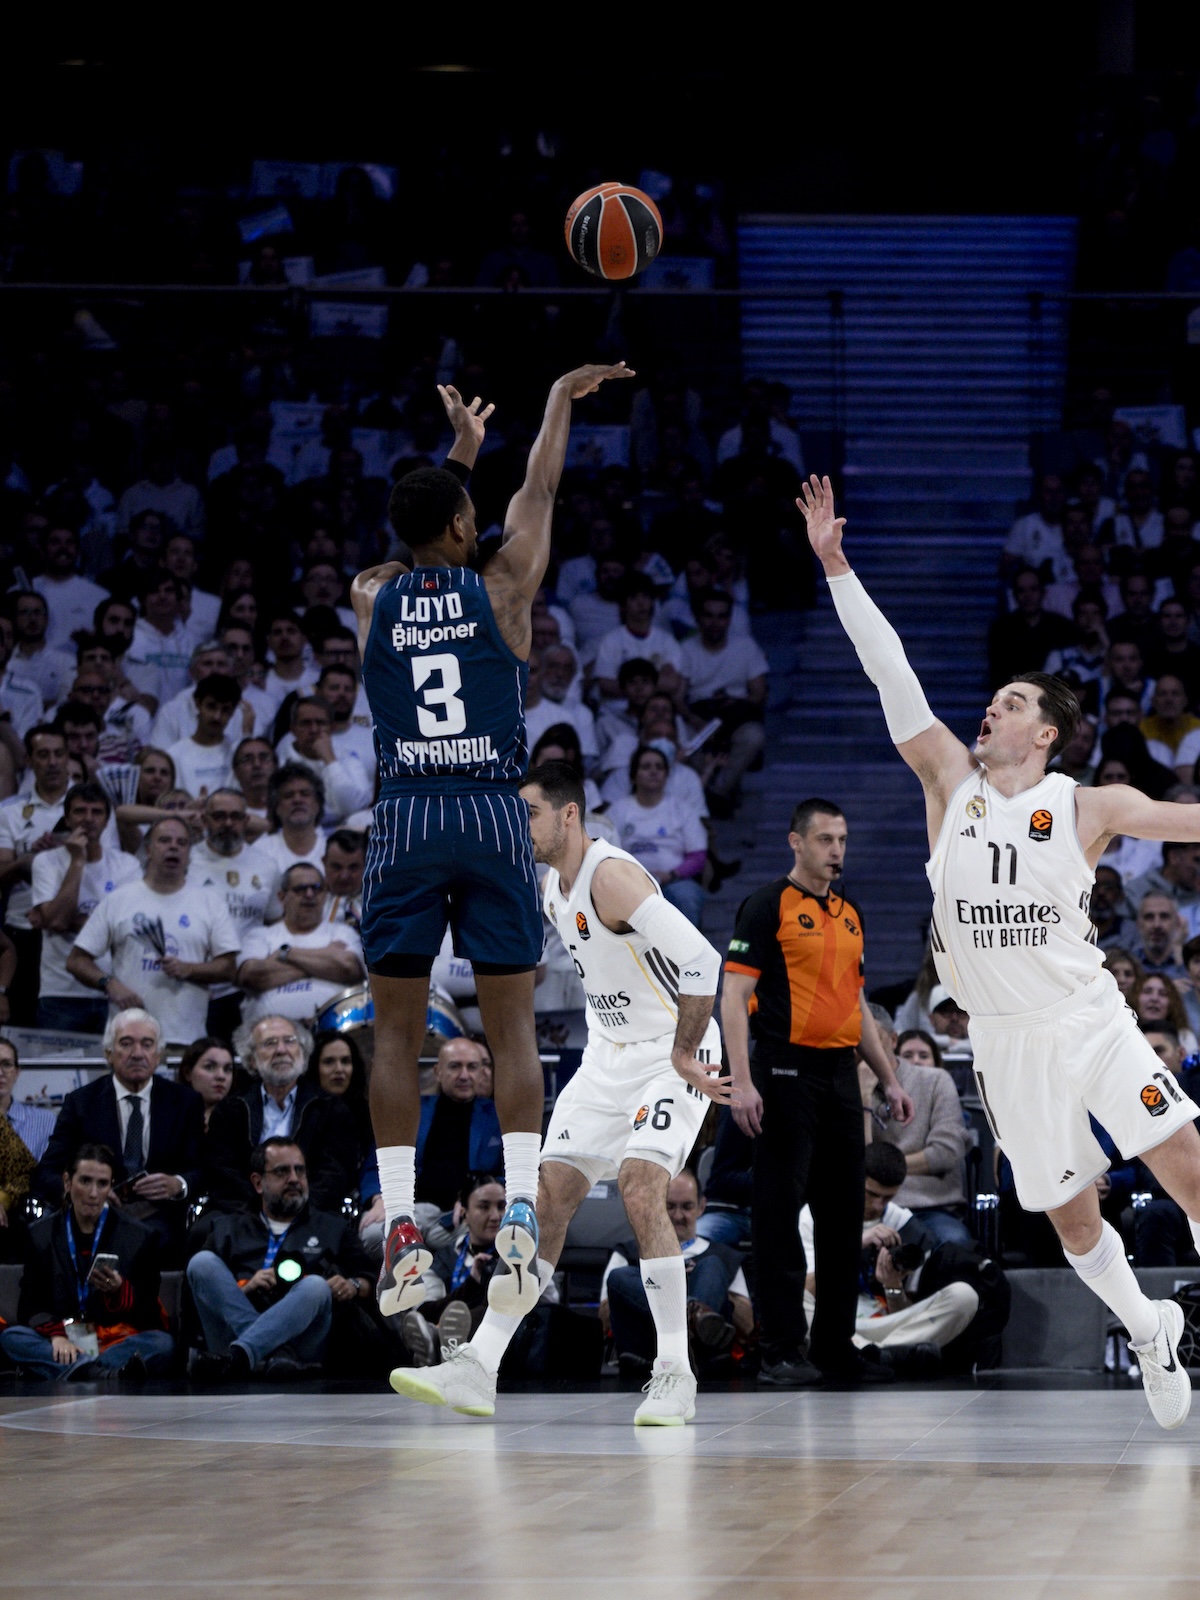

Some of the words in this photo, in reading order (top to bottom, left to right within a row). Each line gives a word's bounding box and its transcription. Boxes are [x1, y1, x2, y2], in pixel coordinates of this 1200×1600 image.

[401, 592, 463, 622] LOYD
[391, 622, 478, 652] Bilyoner
[411, 653, 466, 738] 3
[988, 841, 1018, 885] 11
[956, 899, 1061, 924] Emirates
[973, 929, 994, 949] FLY
[1000, 926, 1048, 948] BETTER
[651, 1098, 675, 1131] 6
